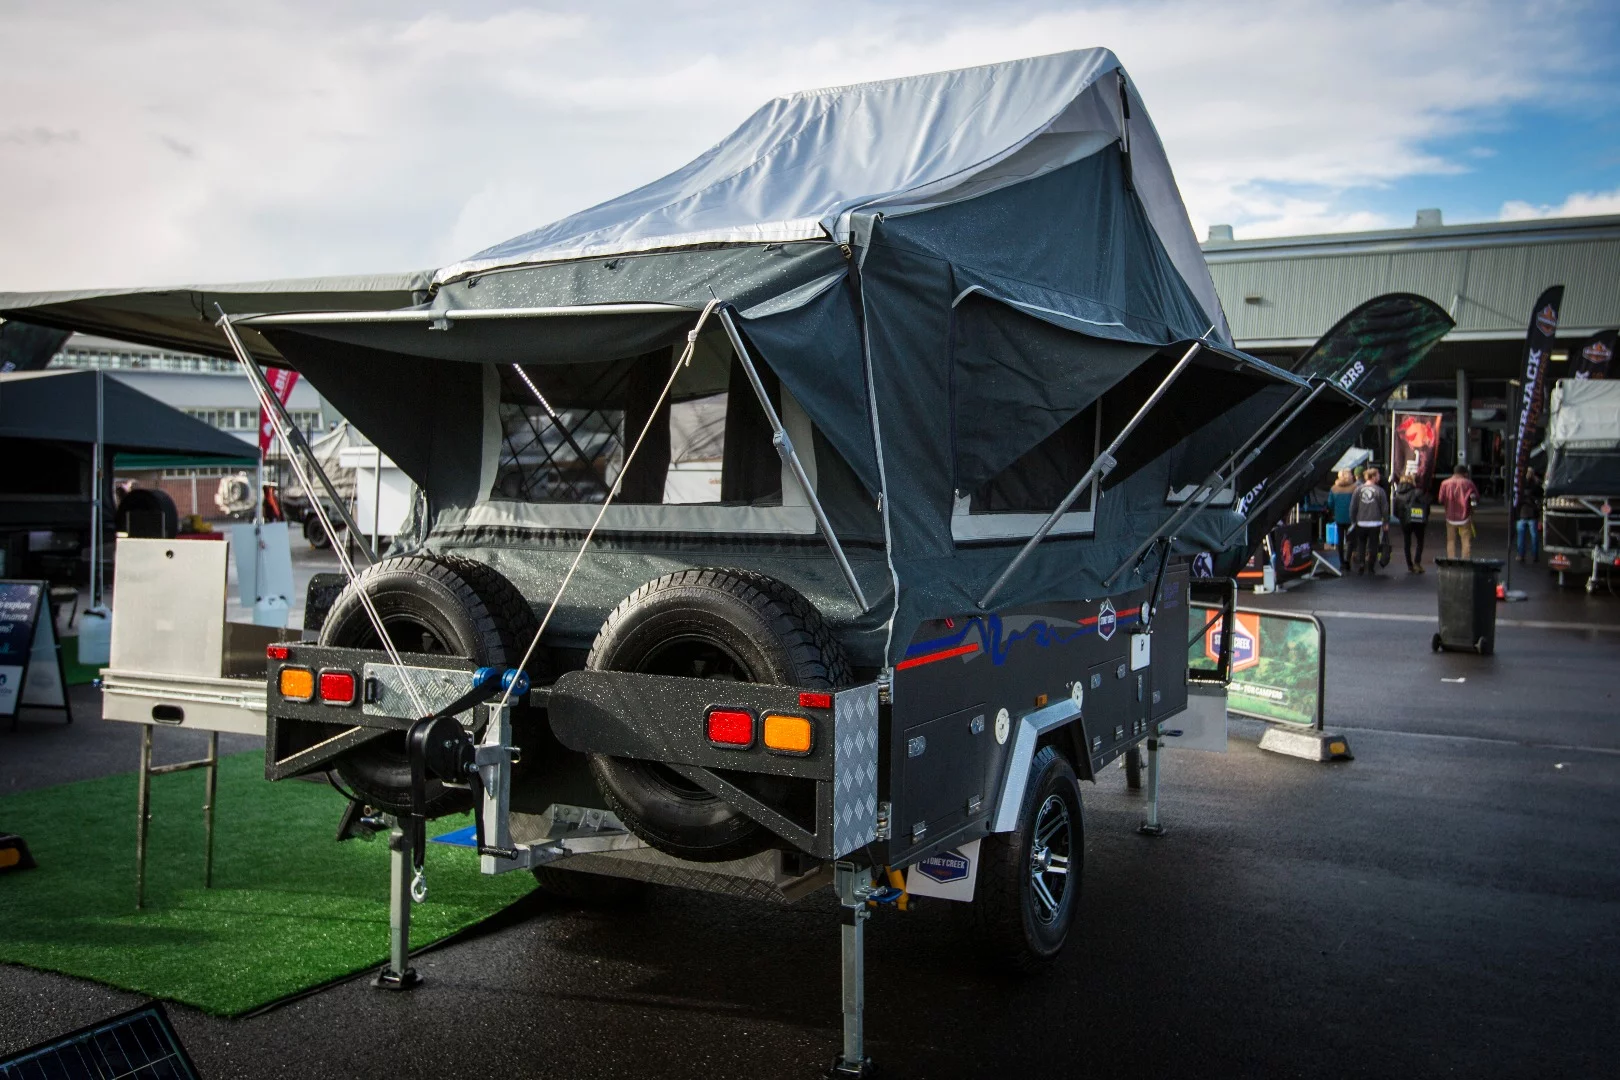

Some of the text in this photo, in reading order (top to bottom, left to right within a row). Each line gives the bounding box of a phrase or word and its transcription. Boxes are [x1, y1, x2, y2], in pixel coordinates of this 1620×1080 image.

[1513, 348, 1542, 508] ERJACK
[1233, 637, 1250, 650] CREEK
[946, 859, 965, 869] CREEK
